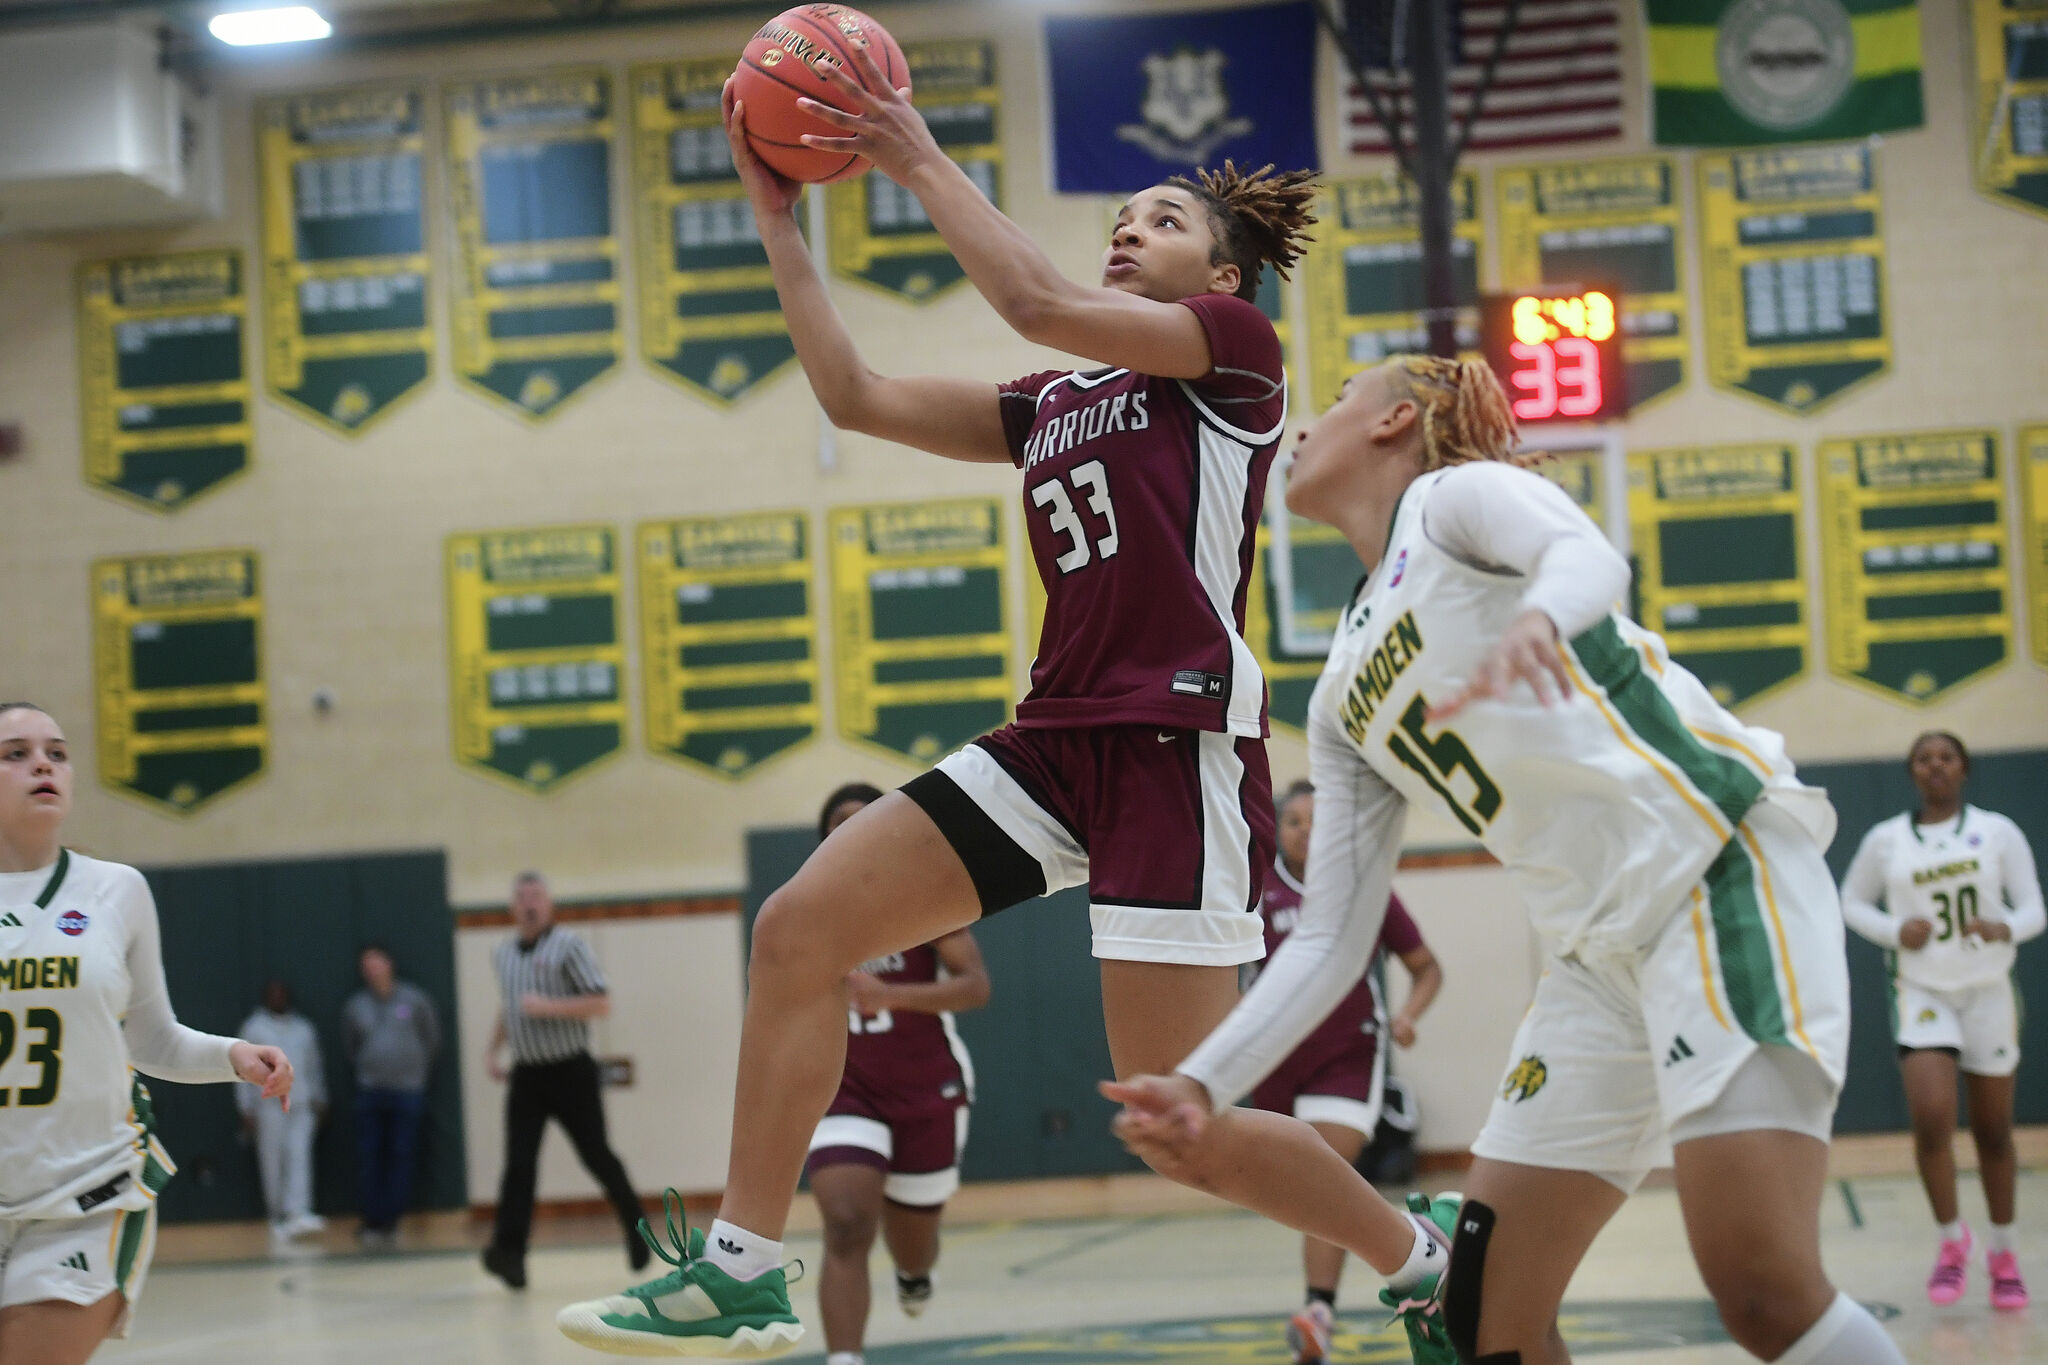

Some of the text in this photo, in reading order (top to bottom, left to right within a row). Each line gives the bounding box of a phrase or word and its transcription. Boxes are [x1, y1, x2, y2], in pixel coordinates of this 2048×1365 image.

[1512, 291, 1615, 345] 6:43
[1509, 337, 1602, 419] 33
[1031, 459, 1119, 575] 33
[1209, 681, 1220, 692] M
[1386, 689, 1504, 837] 15
[1933, 884, 1978, 941] 30
